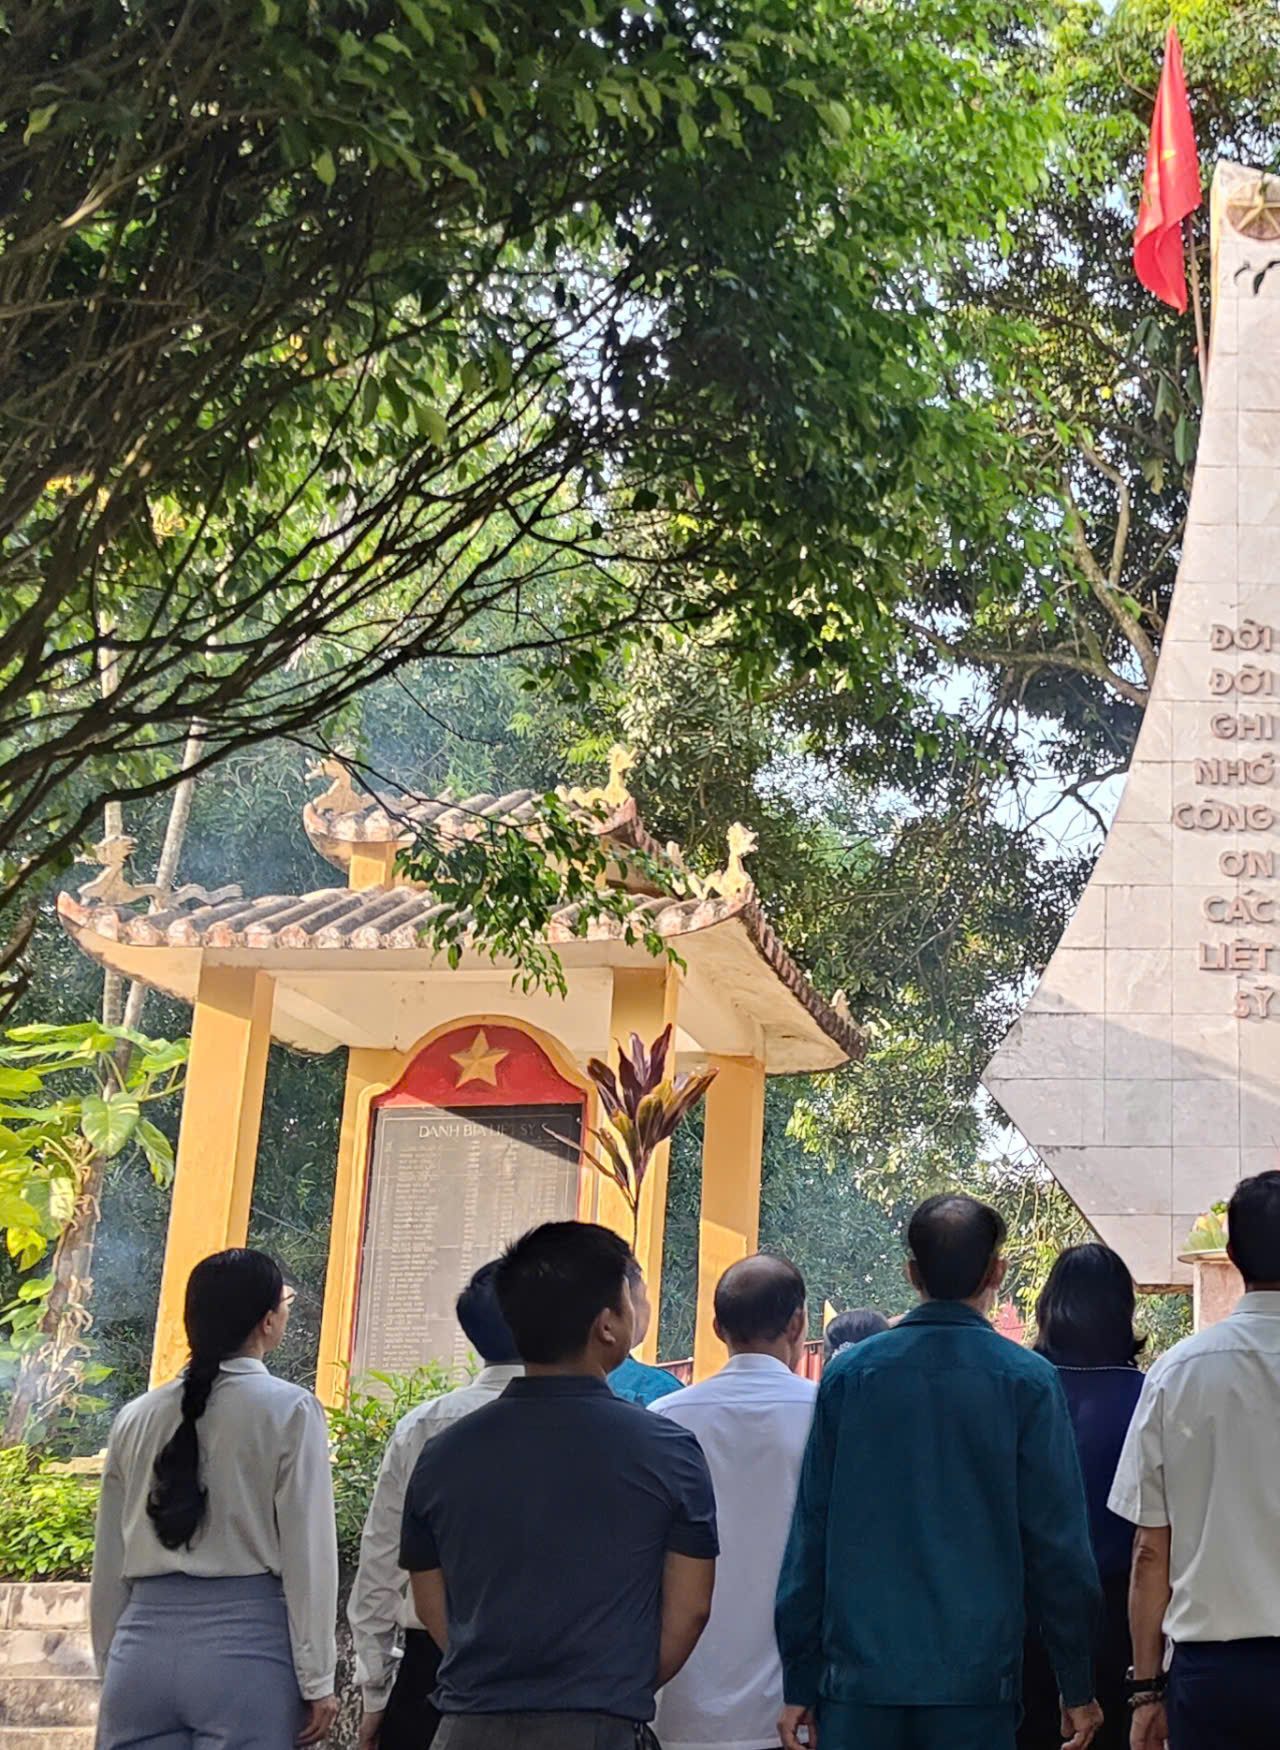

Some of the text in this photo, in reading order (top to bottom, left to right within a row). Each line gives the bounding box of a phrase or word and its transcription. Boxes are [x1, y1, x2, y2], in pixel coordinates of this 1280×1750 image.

[1210, 618, 1273, 652] ĐỜI
[1209, 664, 1273, 695] ĐỜI
[1210, 713, 1273, 741] GHI
[1194, 752, 1275, 785] NHỚ
[1172, 799, 1274, 832] CÔNG
[1218, 850, 1274, 878] ƠN
[1203, 889, 1275, 924] CÁC
[1199, 938, 1274, 978] LIỆT
[1232, 985, 1275, 1019] SỸ
[418, 1125, 460, 1138] DANH
